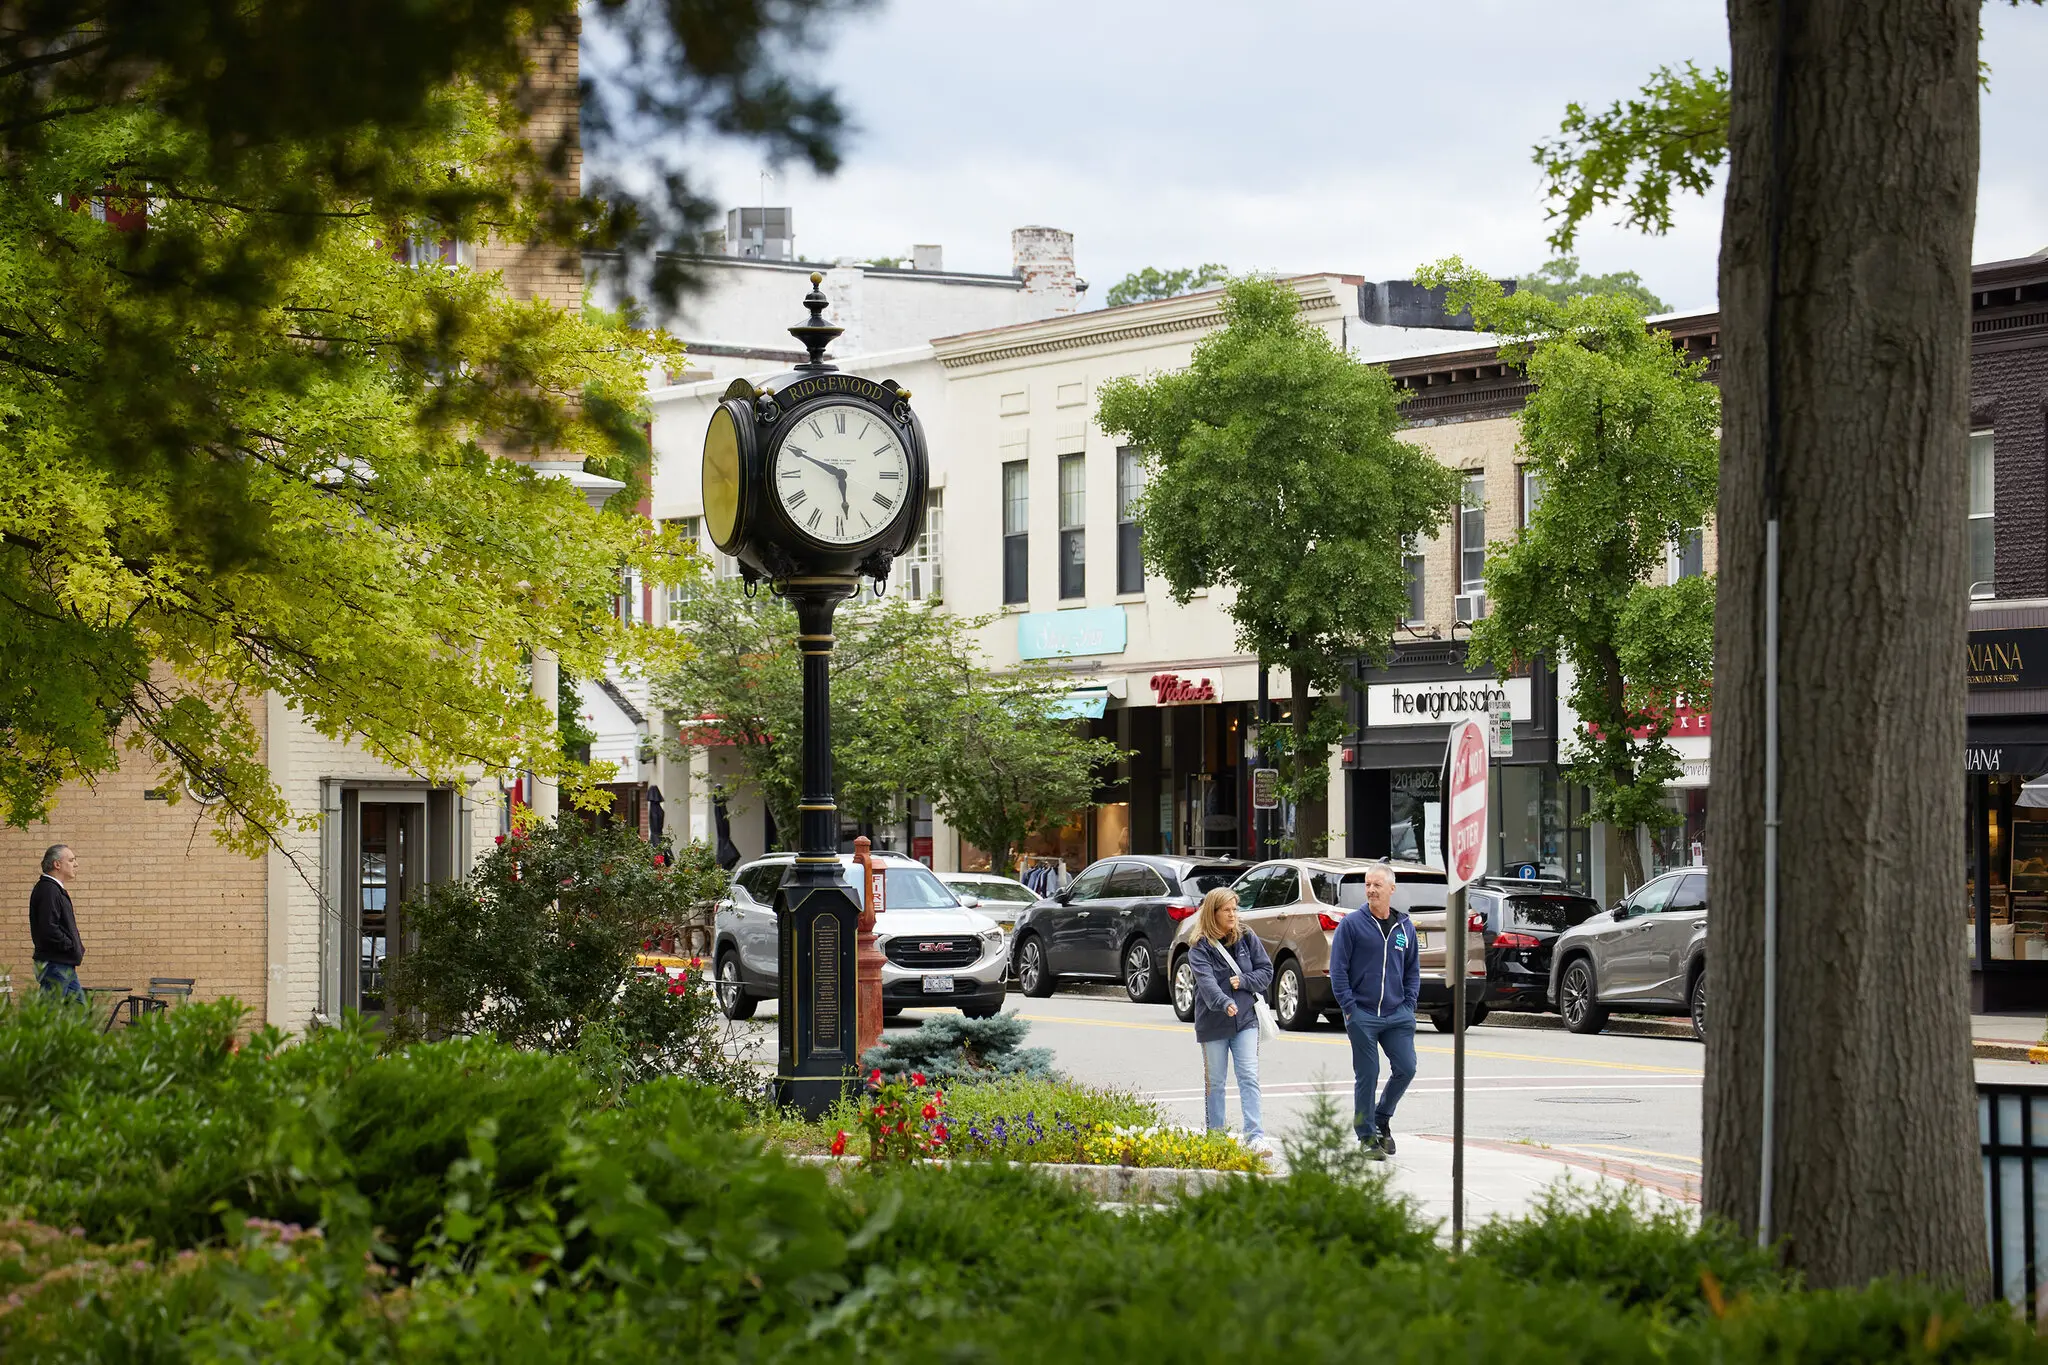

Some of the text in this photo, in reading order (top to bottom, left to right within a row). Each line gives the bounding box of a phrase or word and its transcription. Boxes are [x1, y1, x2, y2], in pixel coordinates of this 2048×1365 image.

[788, 376, 883, 401] RIDGEWOOD
[1967, 642, 2024, 672] XIANA
[1392, 688, 1414, 713] the
[1416, 685, 1468, 719] originals
[1455, 749, 1484, 787] DO NOT
[1682, 760, 1710, 776] Jewelr
[1456, 820, 1480, 856] ENTER
[872, 875, 882, 909] FIRE
[919, 942, 954, 952] GMC
